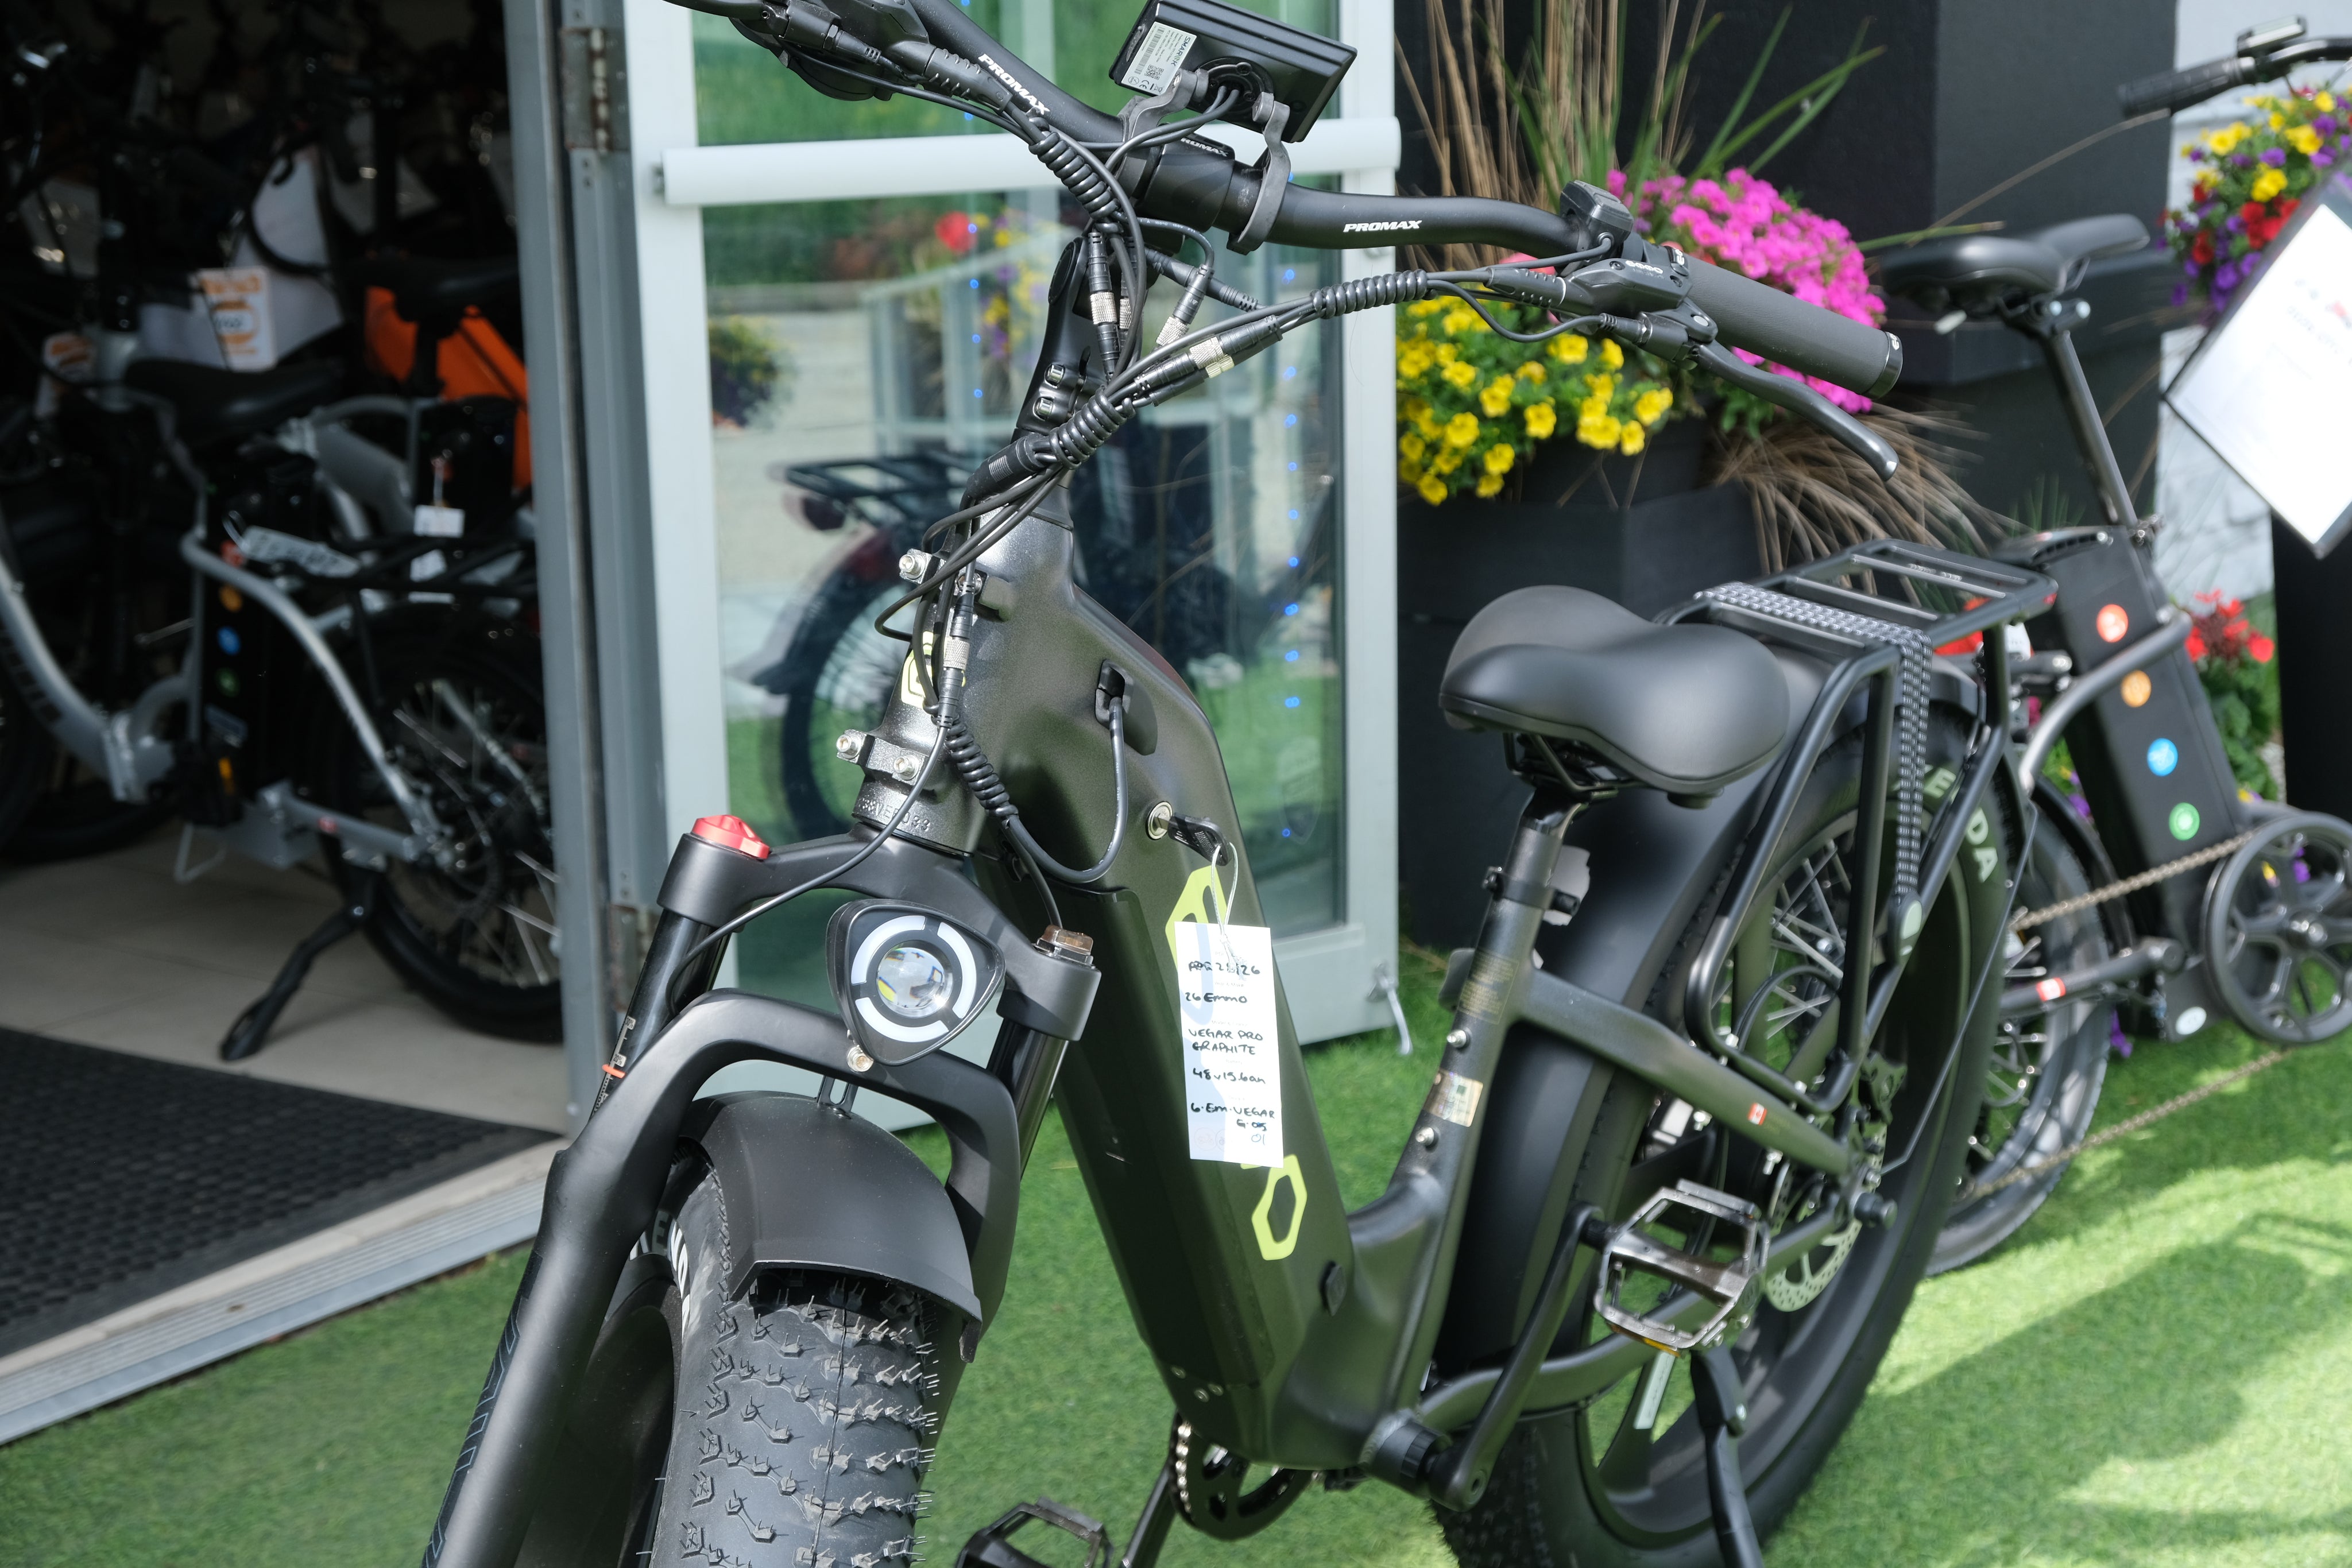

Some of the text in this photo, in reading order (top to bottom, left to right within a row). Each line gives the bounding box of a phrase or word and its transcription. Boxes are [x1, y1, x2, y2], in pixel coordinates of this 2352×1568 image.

[978, 53, 1050, 115] PROMAX
[1180, 137, 1229, 157] ROMAX
[1343, 220, 1422, 233] PROMAX
[1192, 1040, 1256, 1055] GRAPHITE
